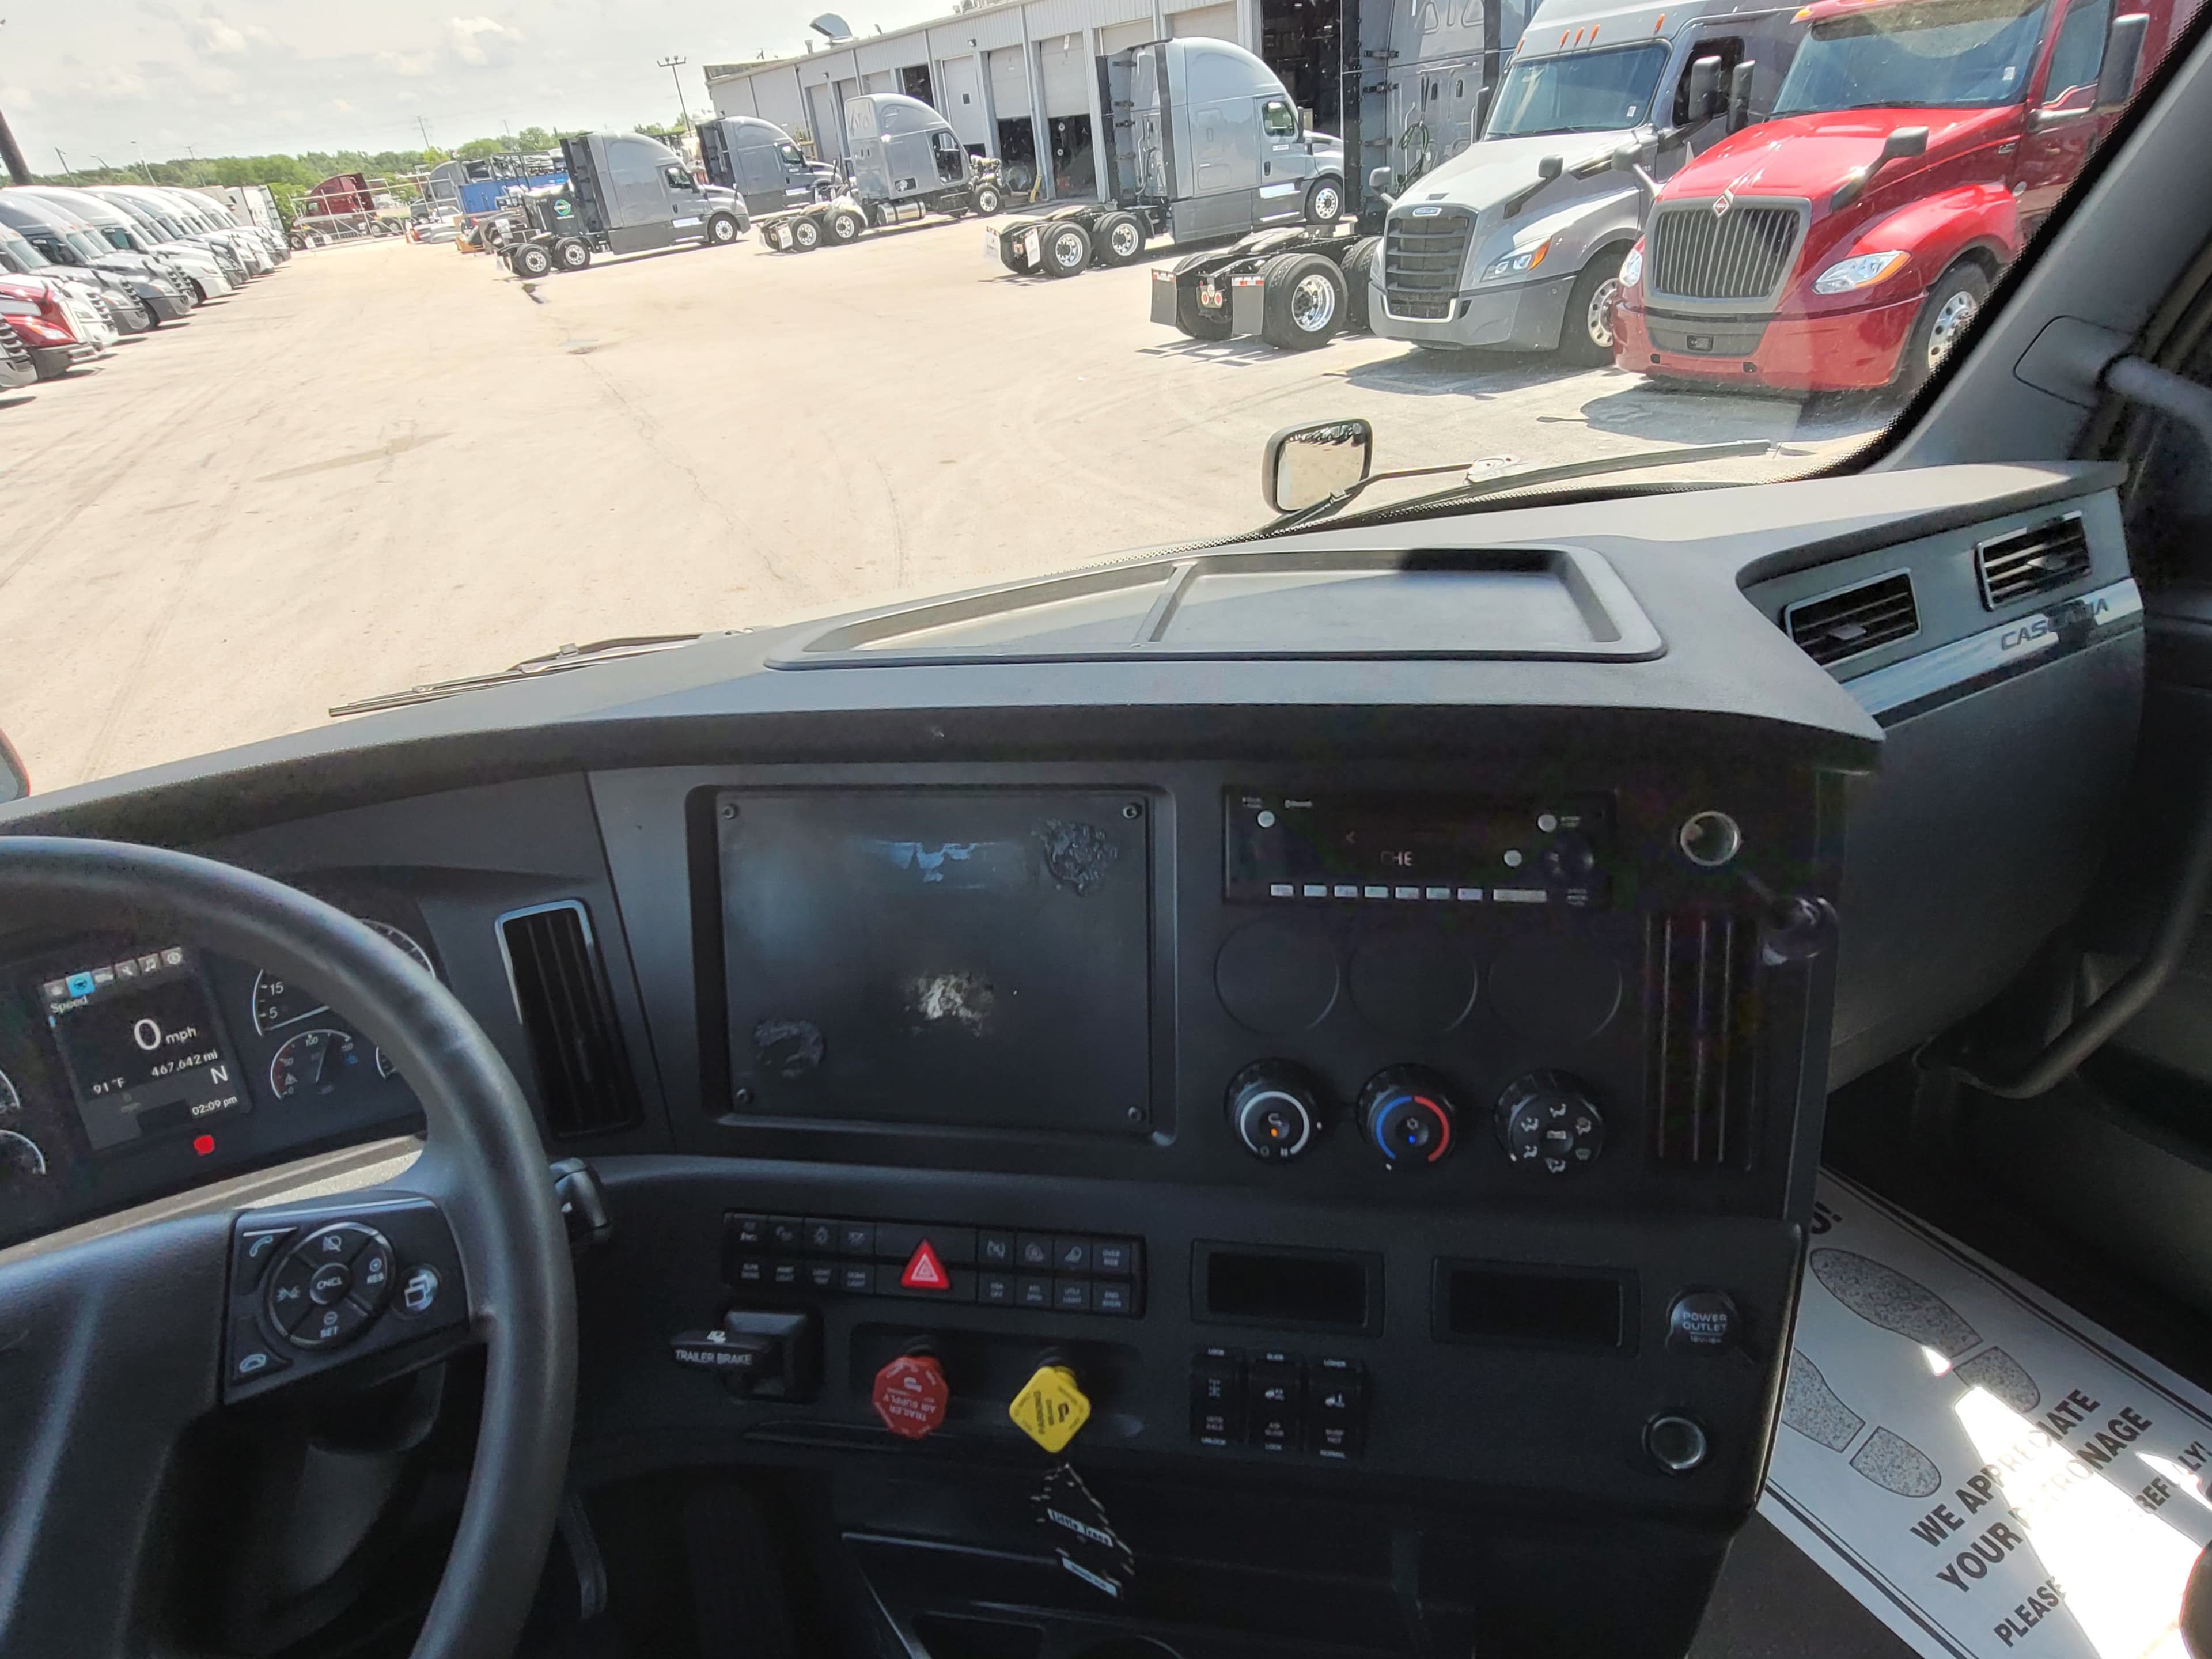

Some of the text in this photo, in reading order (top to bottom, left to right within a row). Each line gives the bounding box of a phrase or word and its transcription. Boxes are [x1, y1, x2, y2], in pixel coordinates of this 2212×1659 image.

[2001, 598, 2109, 650] CASIA
[270, 982, 284, 996] 15
[50, 995, 88, 1014] Speed
[269, 1007, 278, 1020] 5
[134, 1018, 197, 1050] 0 mph
[203, 1049, 218, 1063] mi
[210, 1065, 229, 1084] N
[93, 1082, 109, 1094] 91
[192, 1096, 238, 1116] 02:09 pm
[1683, 1312, 1728, 1323] POWER
[1682, 1322, 1727, 1332] OUTLET
[675, 1349, 752, 1365] TRAILER BRAKE
[1910, 1389, 2101, 1548] WE APPRECIATE
[1936, 1406, 2153, 1593] YOUR PRONAGE
